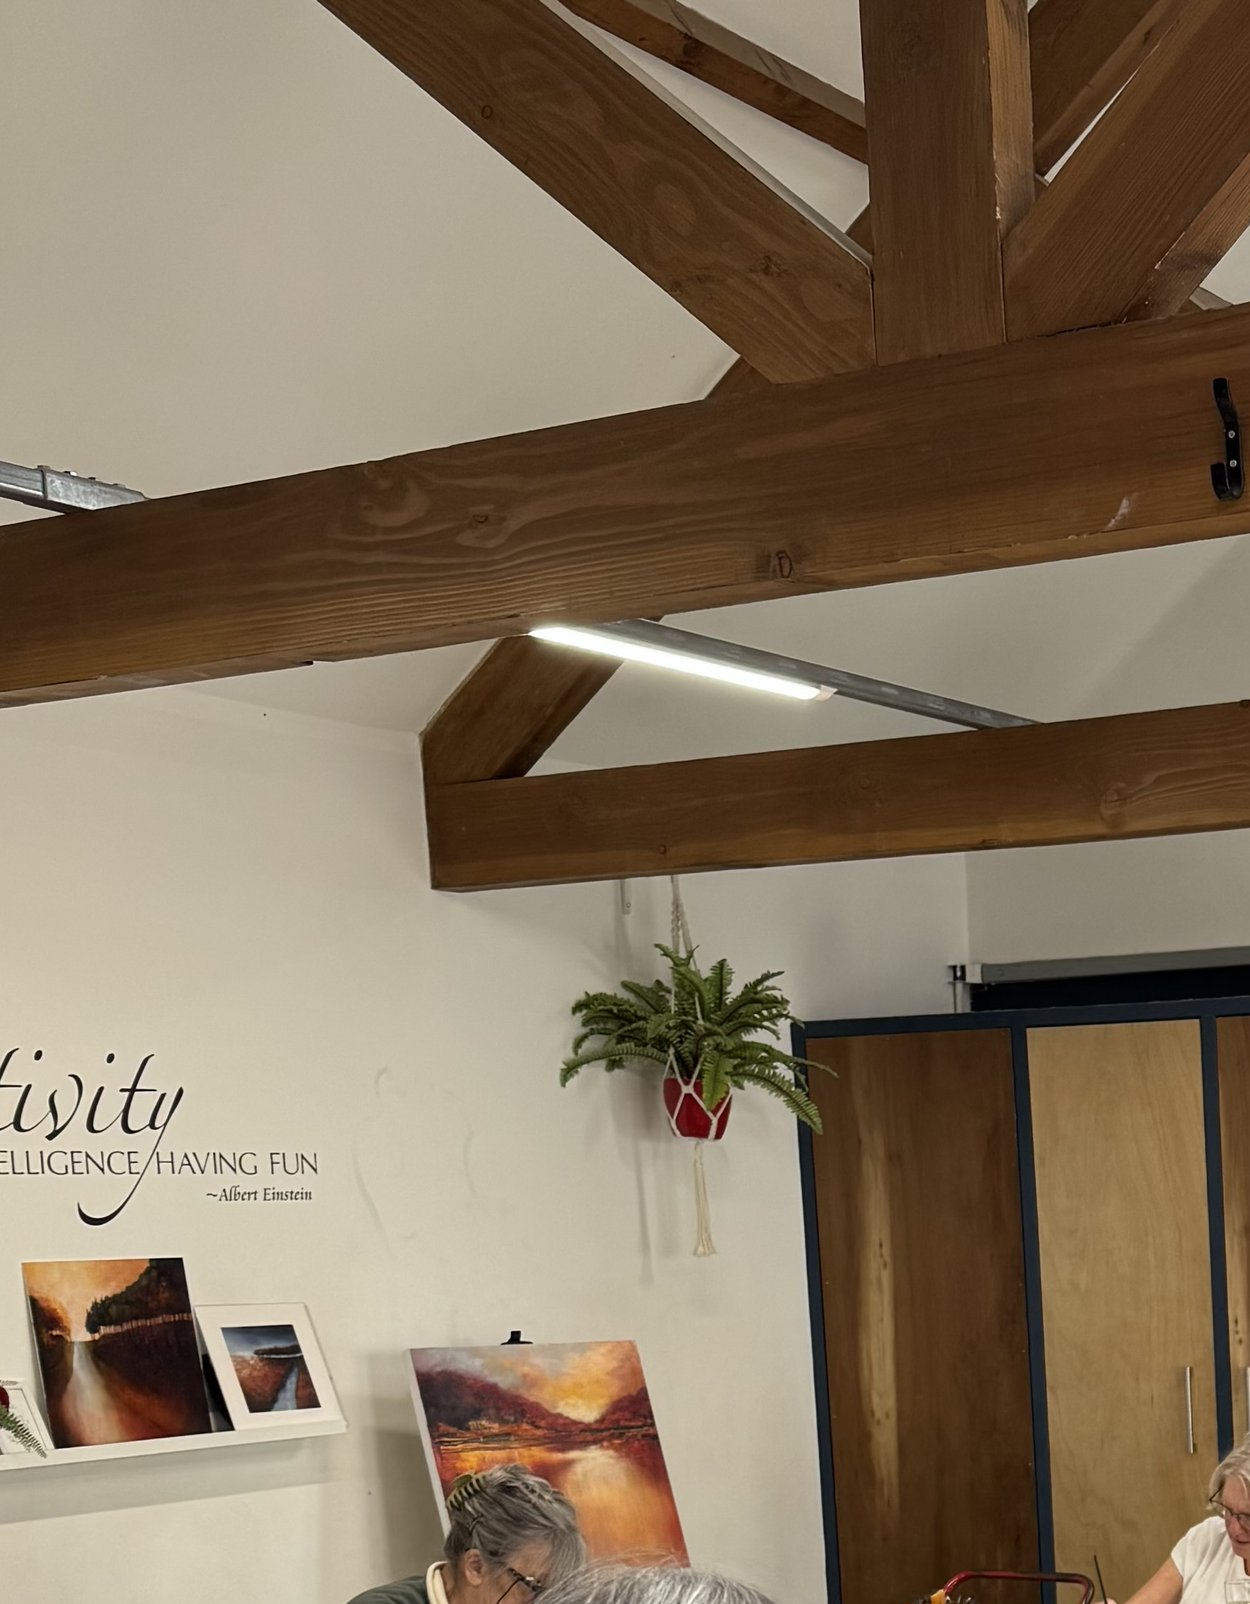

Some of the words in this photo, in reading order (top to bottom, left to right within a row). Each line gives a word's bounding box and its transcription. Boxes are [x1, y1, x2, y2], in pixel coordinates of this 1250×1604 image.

[156, 1151, 258, 1175] HAVING
[269, 1152, 318, 1175] FUN
[263, 1187, 312, 1201] Einstein
